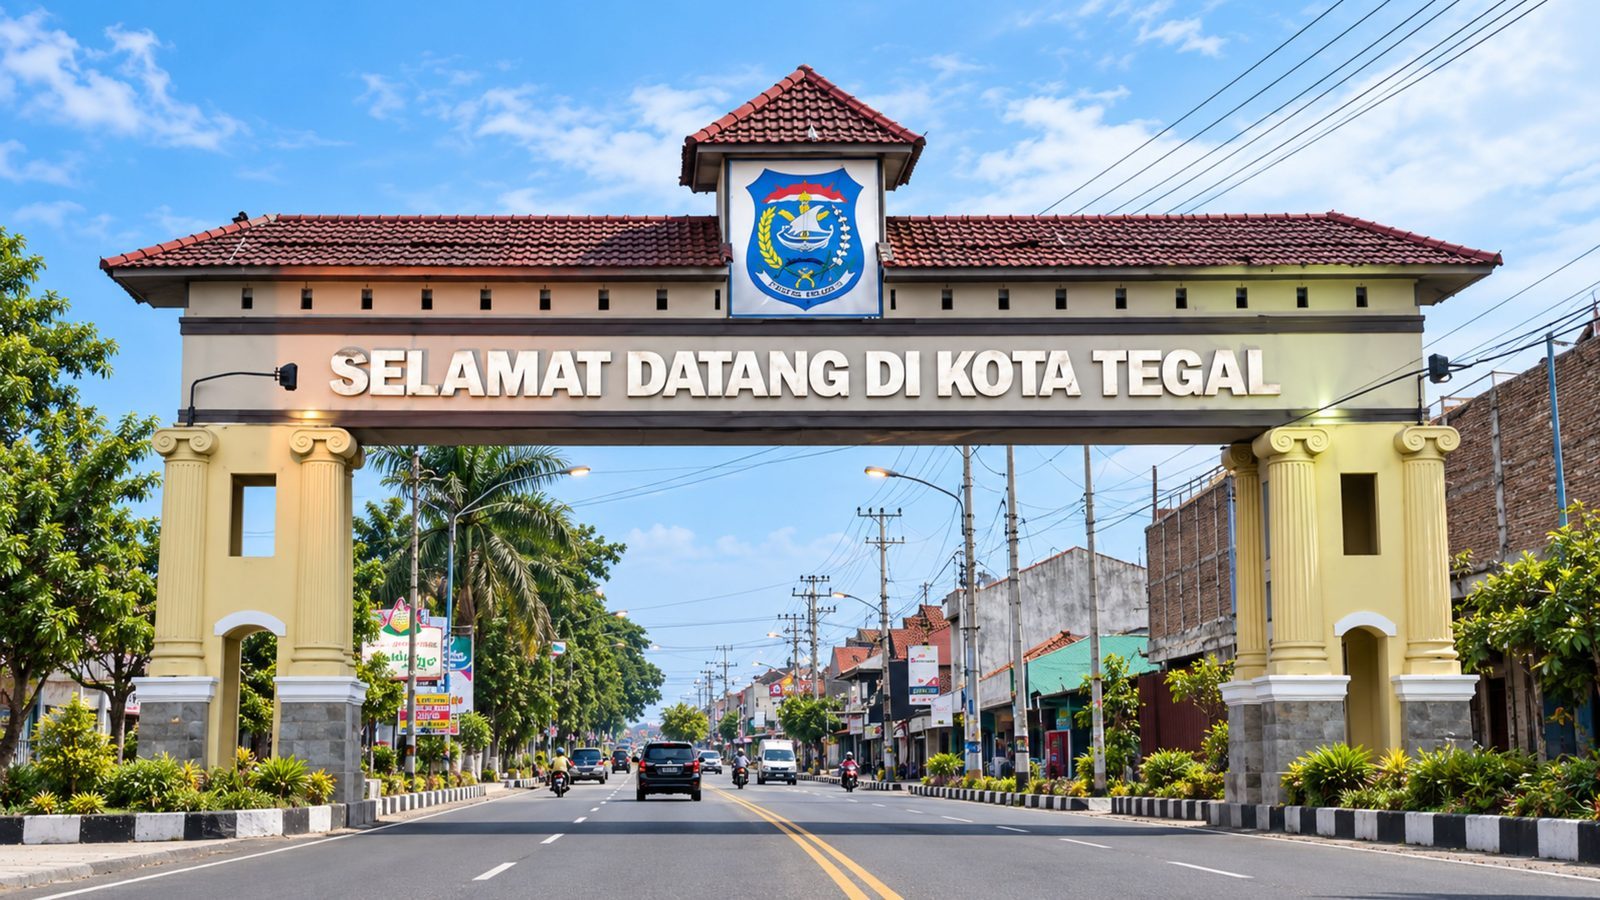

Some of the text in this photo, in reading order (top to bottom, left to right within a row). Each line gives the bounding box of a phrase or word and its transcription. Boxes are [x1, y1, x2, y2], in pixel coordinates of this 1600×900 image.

[329, 349, 1281, 397] SELAMAT DATANG DI KOTA TEGAL
